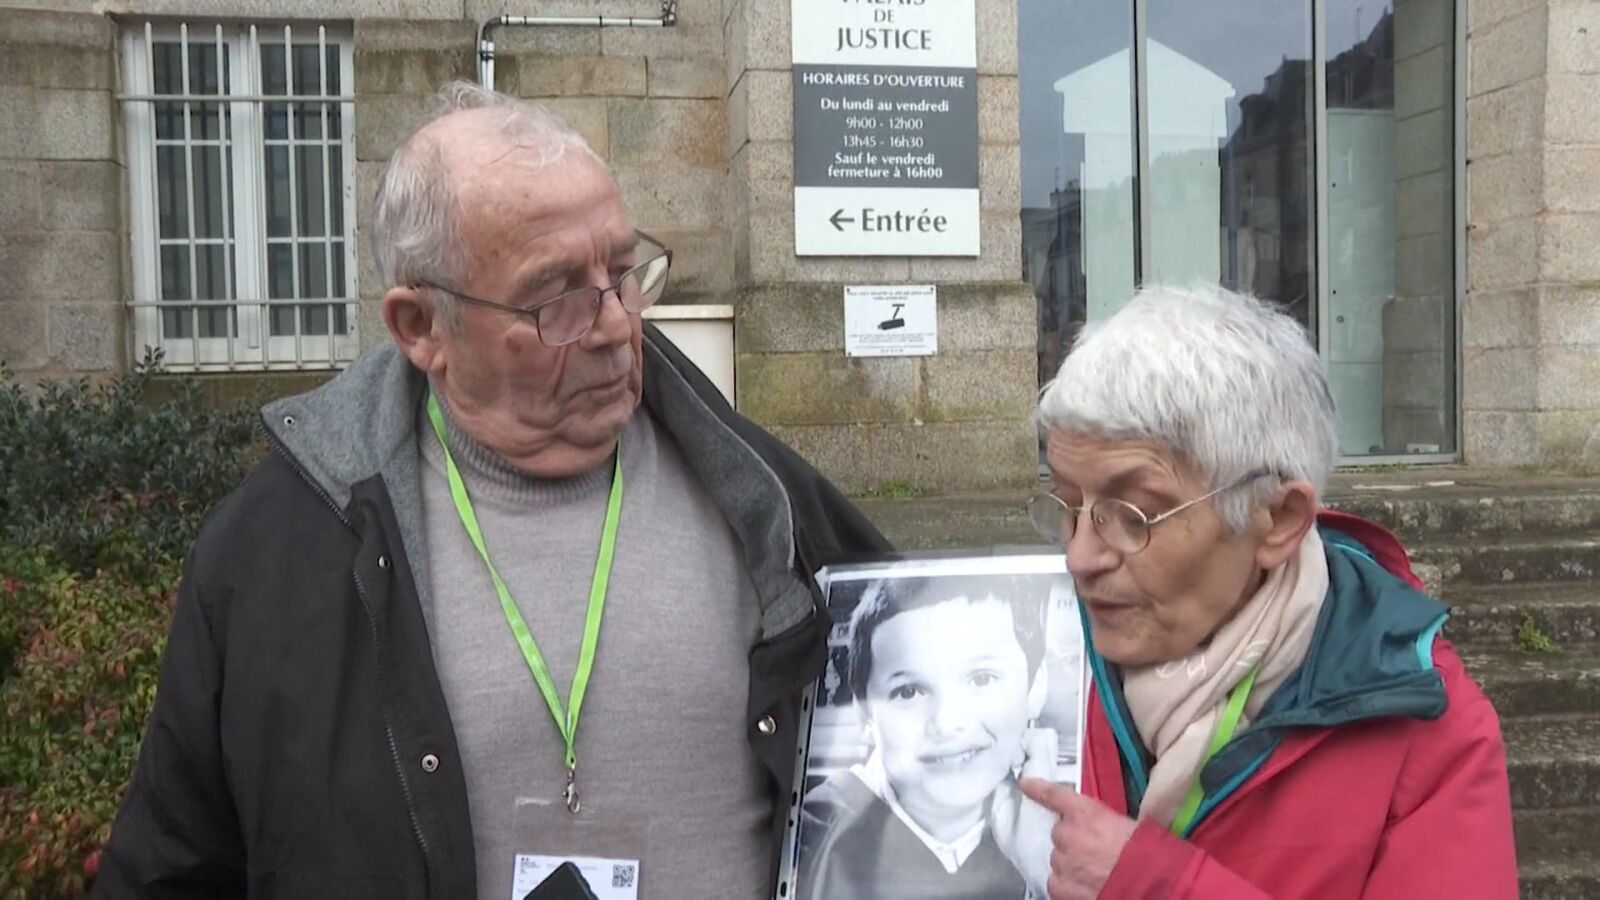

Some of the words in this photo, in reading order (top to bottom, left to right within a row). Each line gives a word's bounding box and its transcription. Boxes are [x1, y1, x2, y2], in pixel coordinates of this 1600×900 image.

[874, 9, 895, 23] DE
[837, 27, 932, 51] JUSTICE
[803, 72, 870, 86] HORAIRES
[873, 74, 965, 88] D'OUVERTURE
[820, 98, 839, 110] Du
[843, 97, 874, 111] lundi
[877, 101, 892, 111] au
[896, 99, 949, 112] vendredi
[845, 117, 877, 129] 9h00
[889, 118, 923, 130] 12h00
[843, 135, 877, 147] 13h45
[890, 136, 924, 148] 16h30
[835, 152, 863, 164] Sauf
[866, 152, 877, 164] le
[882, 153, 935, 165] vendredi
[828, 165, 890, 178] fermeture
[893, 166, 901, 178] à
[906, 167, 943, 179] 16h00
[862, 208, 947, 232] Entrée
